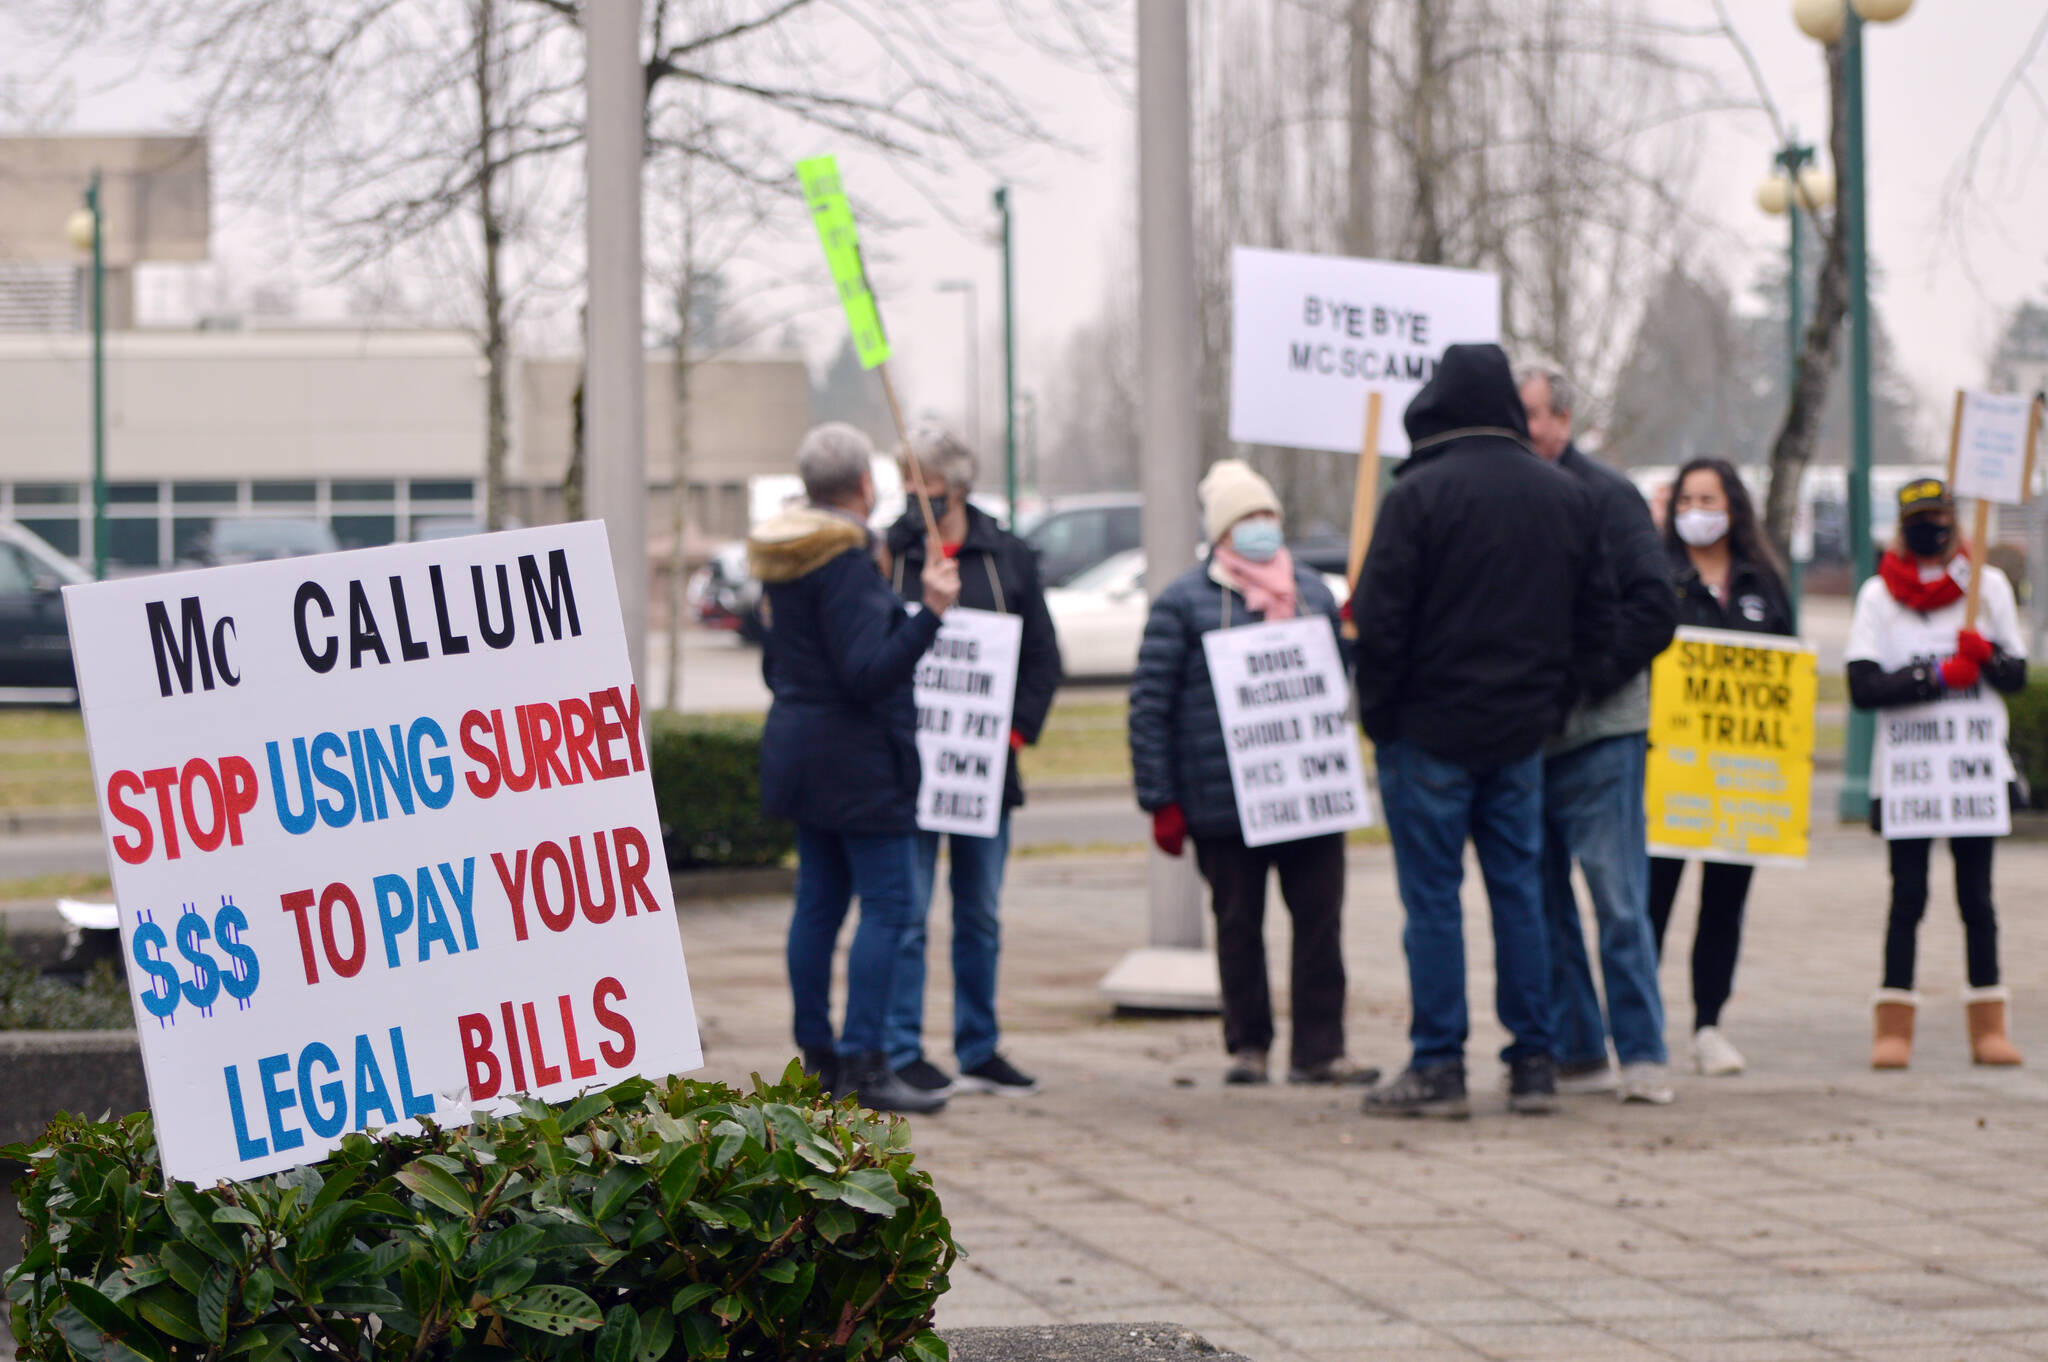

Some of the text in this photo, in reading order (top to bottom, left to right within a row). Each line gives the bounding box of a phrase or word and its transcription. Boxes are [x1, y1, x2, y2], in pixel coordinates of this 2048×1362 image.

[1304, 296, 1429, 344] BYE BYE
[293, 549, 582, 673] CALLUM
[928, 637, 980, 662] OUG
[1247, 649, 1305, 675] DOUG
[1679, 641, 1794, 676] SURREY
[1684, 677, 1792, 713] MAYOR
[963, 711, 1000, 739] PAY
[1232, 717, 1303, 750] SHOULD
[1701, 713, 1787, 749] TRIAL
[1890, 717, 1995, 746] SHOULD PAY
[107, 683, 644, 865] STOP USING SURREY
[938, 751, 991, 778] OWN
[1243, 752, 1349, 790] HIS OWN
[1892, 757, 1993, 784] HIS OWN
[1309, 790, 1356, 817] BILLS
[1952, 796, 1996, 820] BILLS
[133, 826, 661, 1030] $$$ TO PAY YOUR
[224, 976, 636, 1162] LEGAL BILLS
